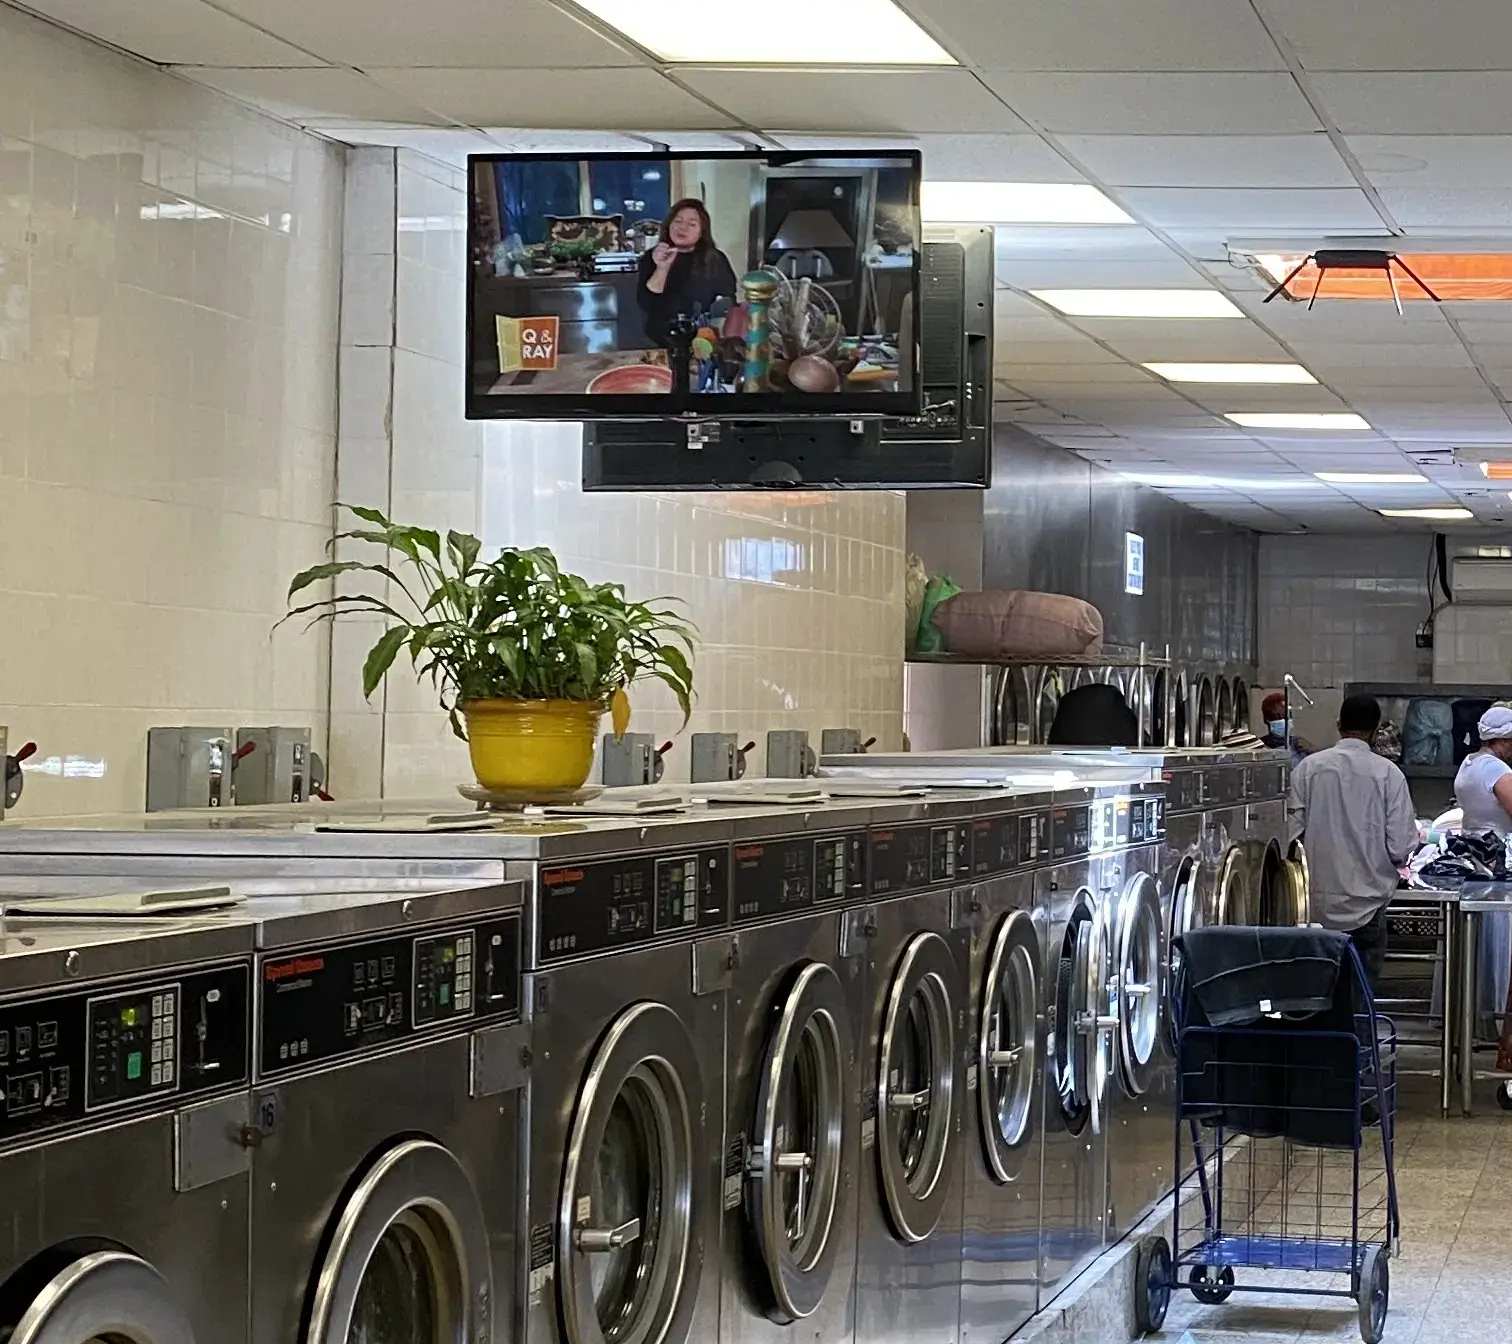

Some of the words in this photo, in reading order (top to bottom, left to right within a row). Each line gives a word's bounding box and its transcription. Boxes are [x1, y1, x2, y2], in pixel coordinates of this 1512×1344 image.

[522, 328, 537, 344] Q
[540, 329, 553, 343] &
[522, 344, 553, 359] RAY
